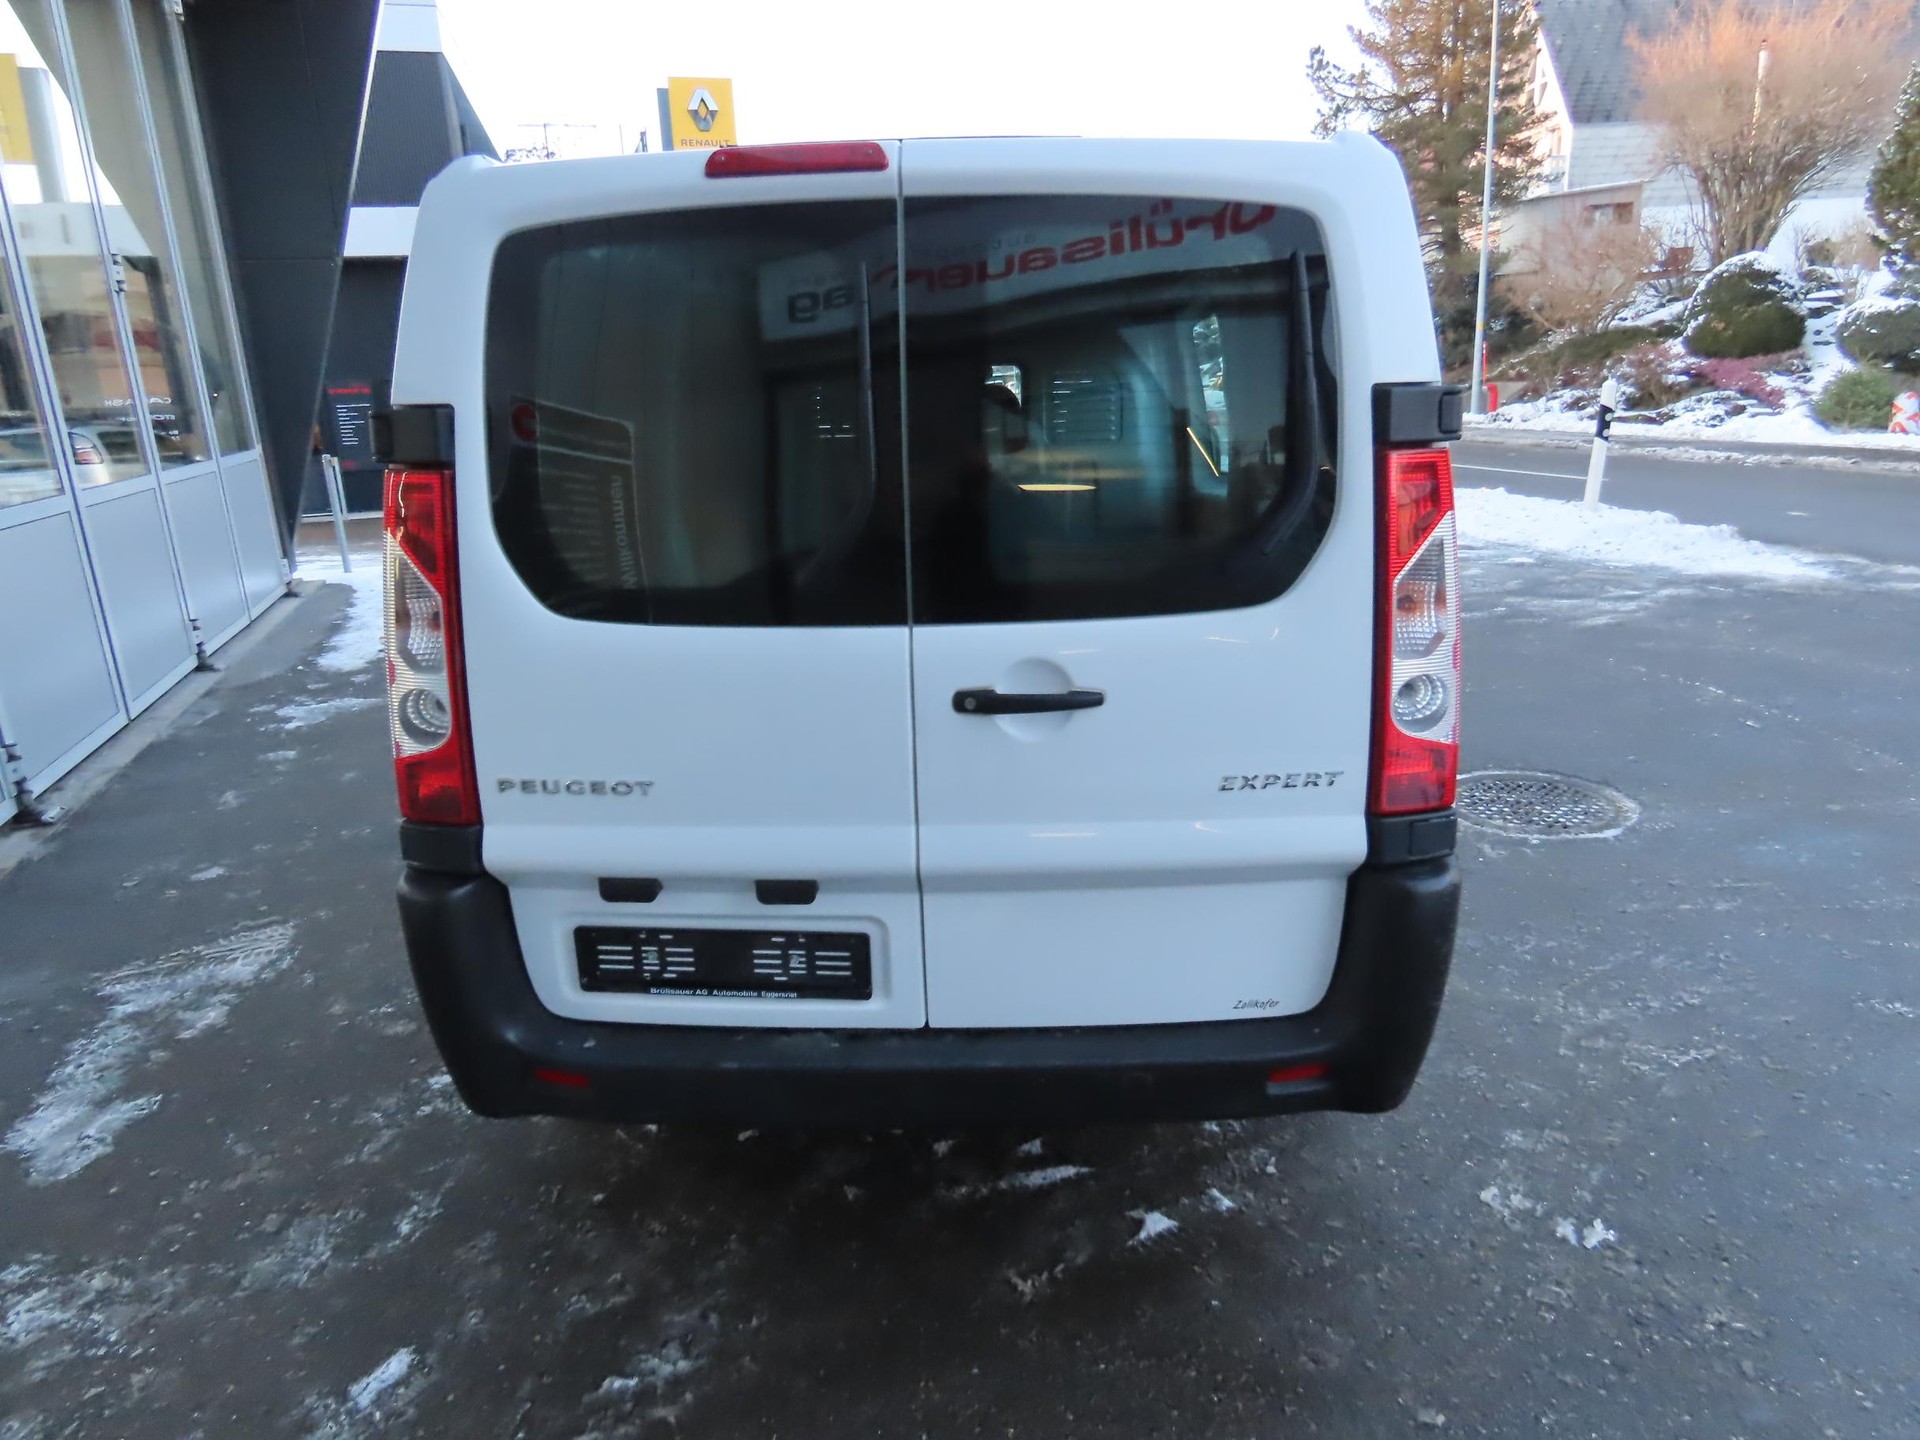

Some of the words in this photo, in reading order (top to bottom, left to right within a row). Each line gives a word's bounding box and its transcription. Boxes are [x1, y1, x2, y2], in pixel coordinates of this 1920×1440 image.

[680, 138, 730, 148] RENAULT
[497, 778, 655, 797] PEUGEOT
[1218, 771, 1345, 792] EXPERT
[712, 989, 758, 998] Automobile
